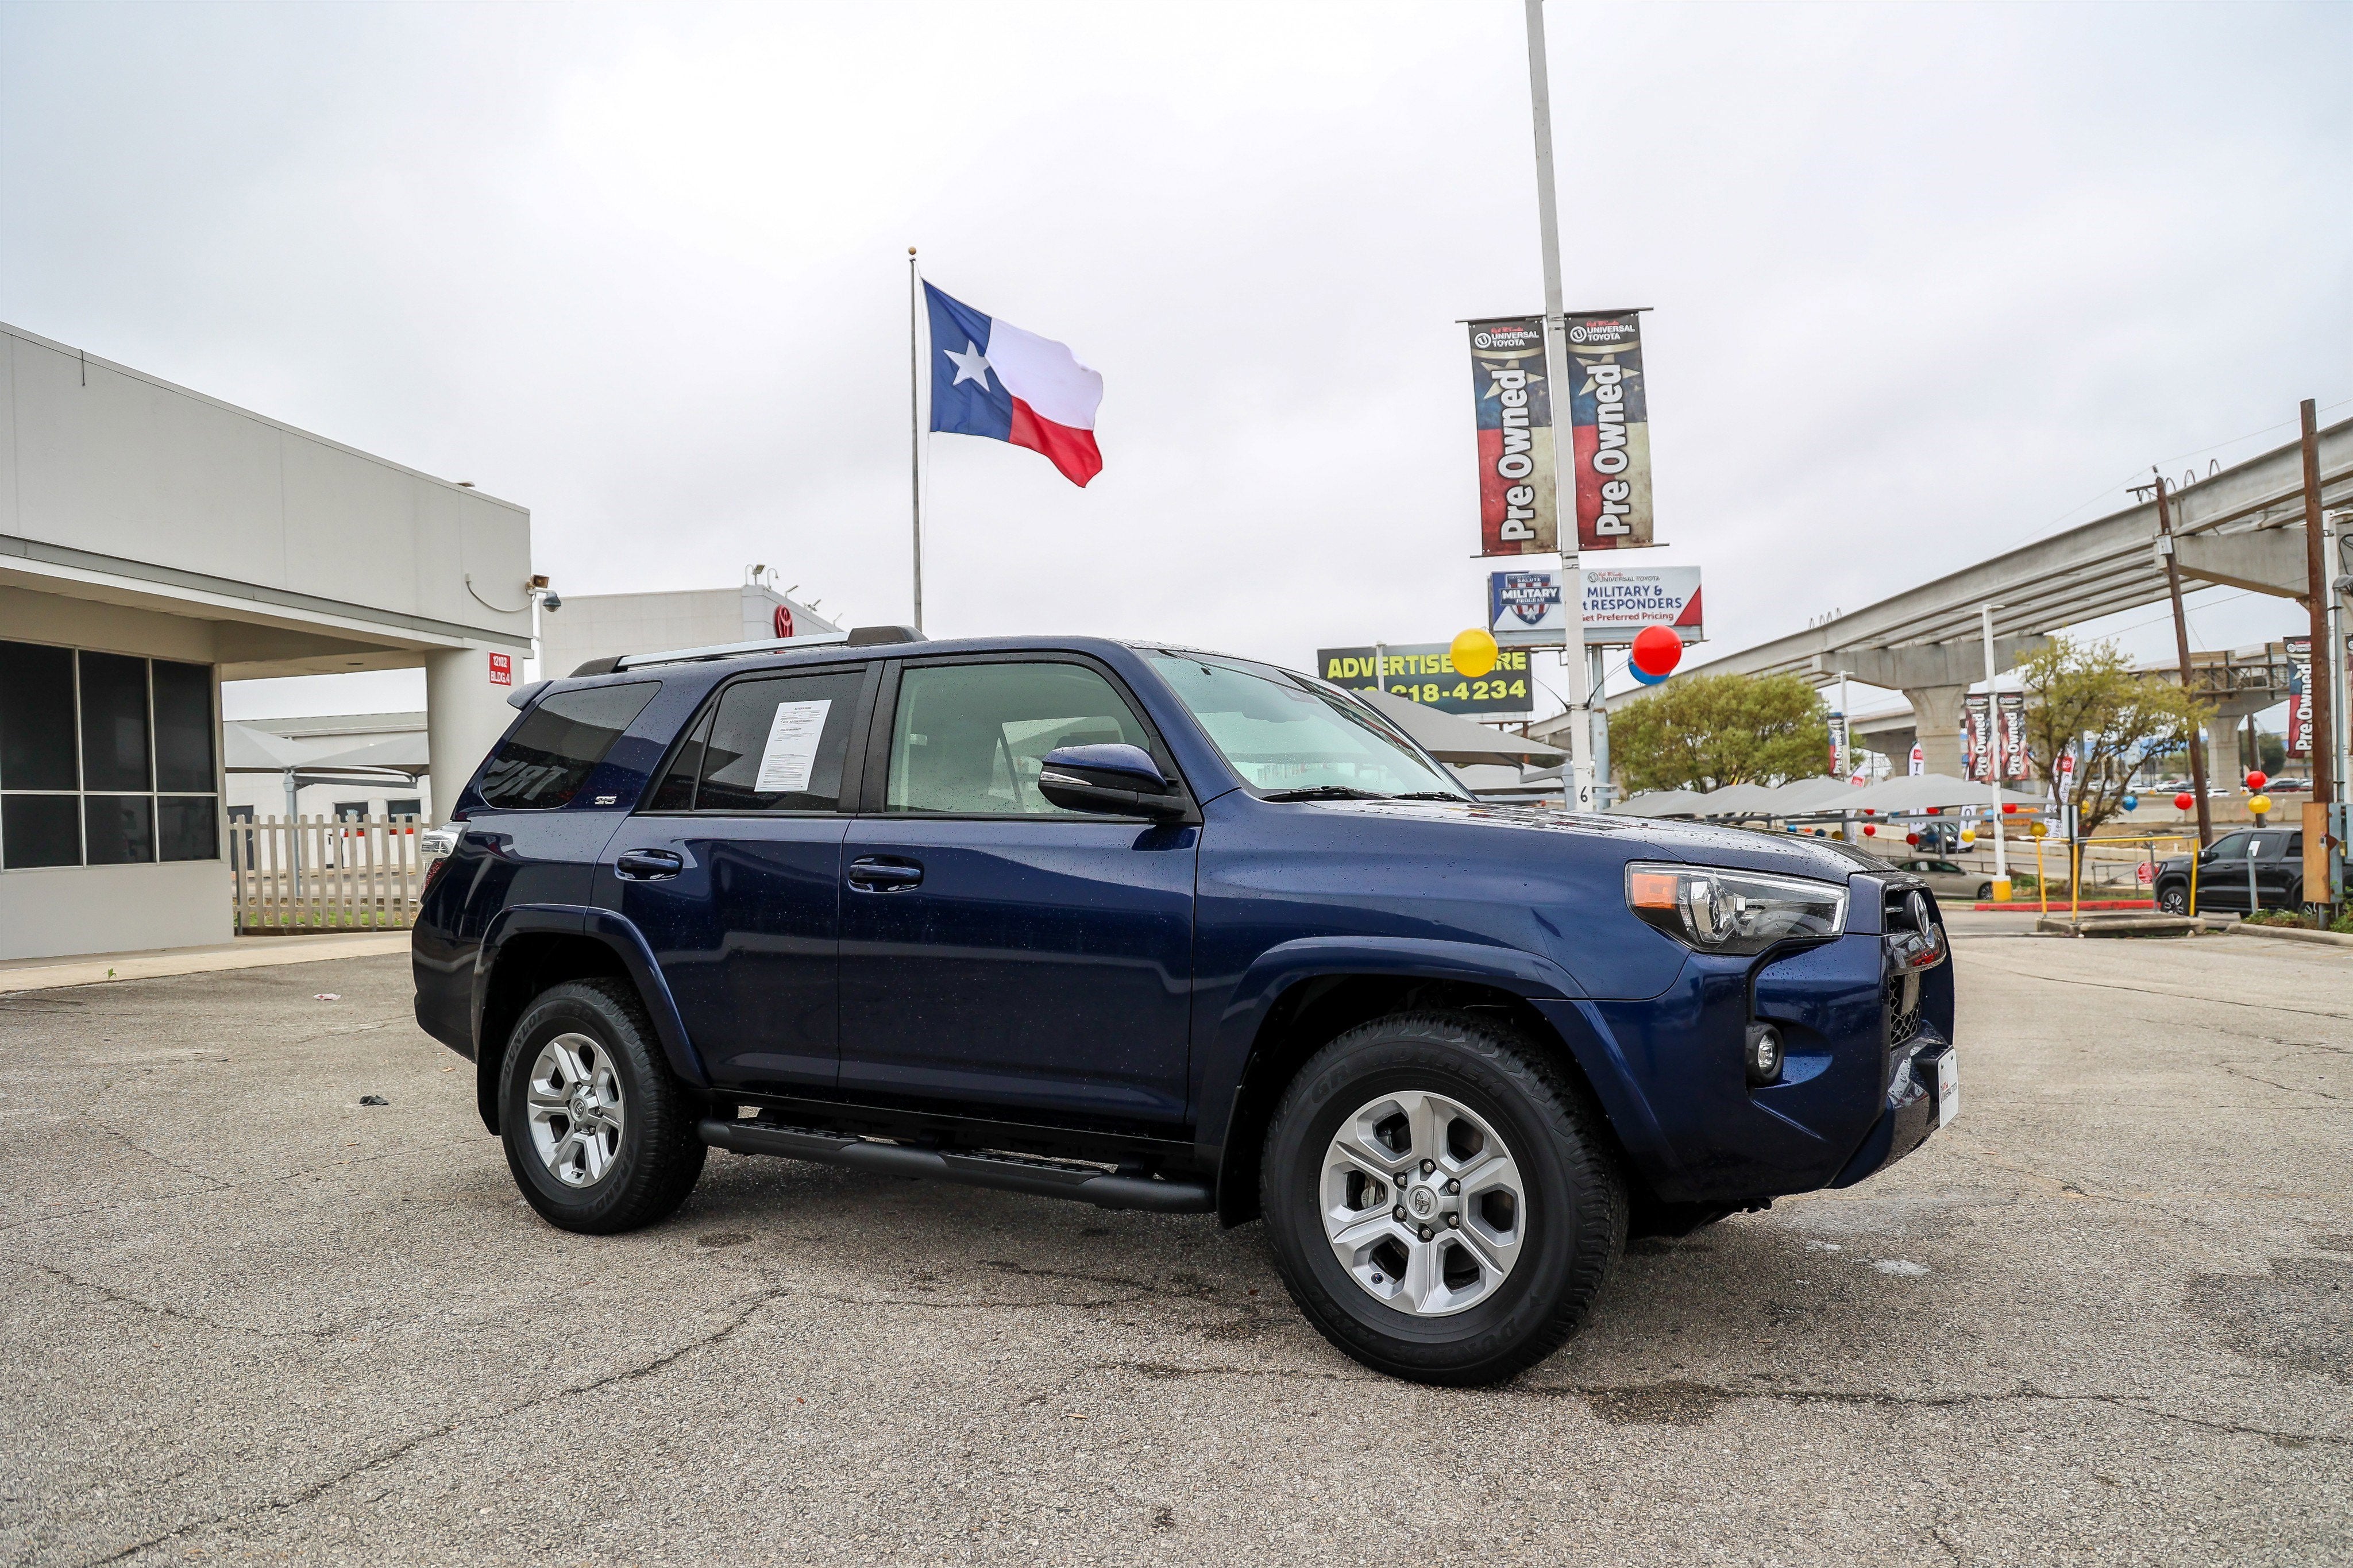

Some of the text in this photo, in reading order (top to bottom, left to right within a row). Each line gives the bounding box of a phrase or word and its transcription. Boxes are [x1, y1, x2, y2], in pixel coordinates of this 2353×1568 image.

[1492, 331, 1540, 340] UNIVERSAL
[1587, 325, 1635, 334] UNIVERSAL
[1587, 333, 1621, 342] TOYOTA
[1492, 339, 1525, 347] TOYOTA
[1491, 369, 1533, 480] Owned
[1586, 364, 1629, 474] Owned
[1500, 485, 1535, 541] Pre
[1596, 480, 1630, 536] Pre
[1502, 588, 1558, 599] MILITARY
[1587, 585, 1663, 598] MILITARY &
[1591, 597, 1683, 611] RESPONDERS
[1597, 612, 1640, 621] Preferred
[1642, 612, 1674, 621] Pricing
[1327, 654, 1455, 679] ADVERTISE
[1972, 713, 1987, 754] Owned
[2004, 712, 2020, 754] Owned
[1975, 755, 1988, 776] Pre
[2007, 755, 2021, 776] Pre
[595, 795, 618, 805] SR5
[1580, 786, 1588, 803] 6
[1312, 1046, 1507, 1103] GRANDTREK
